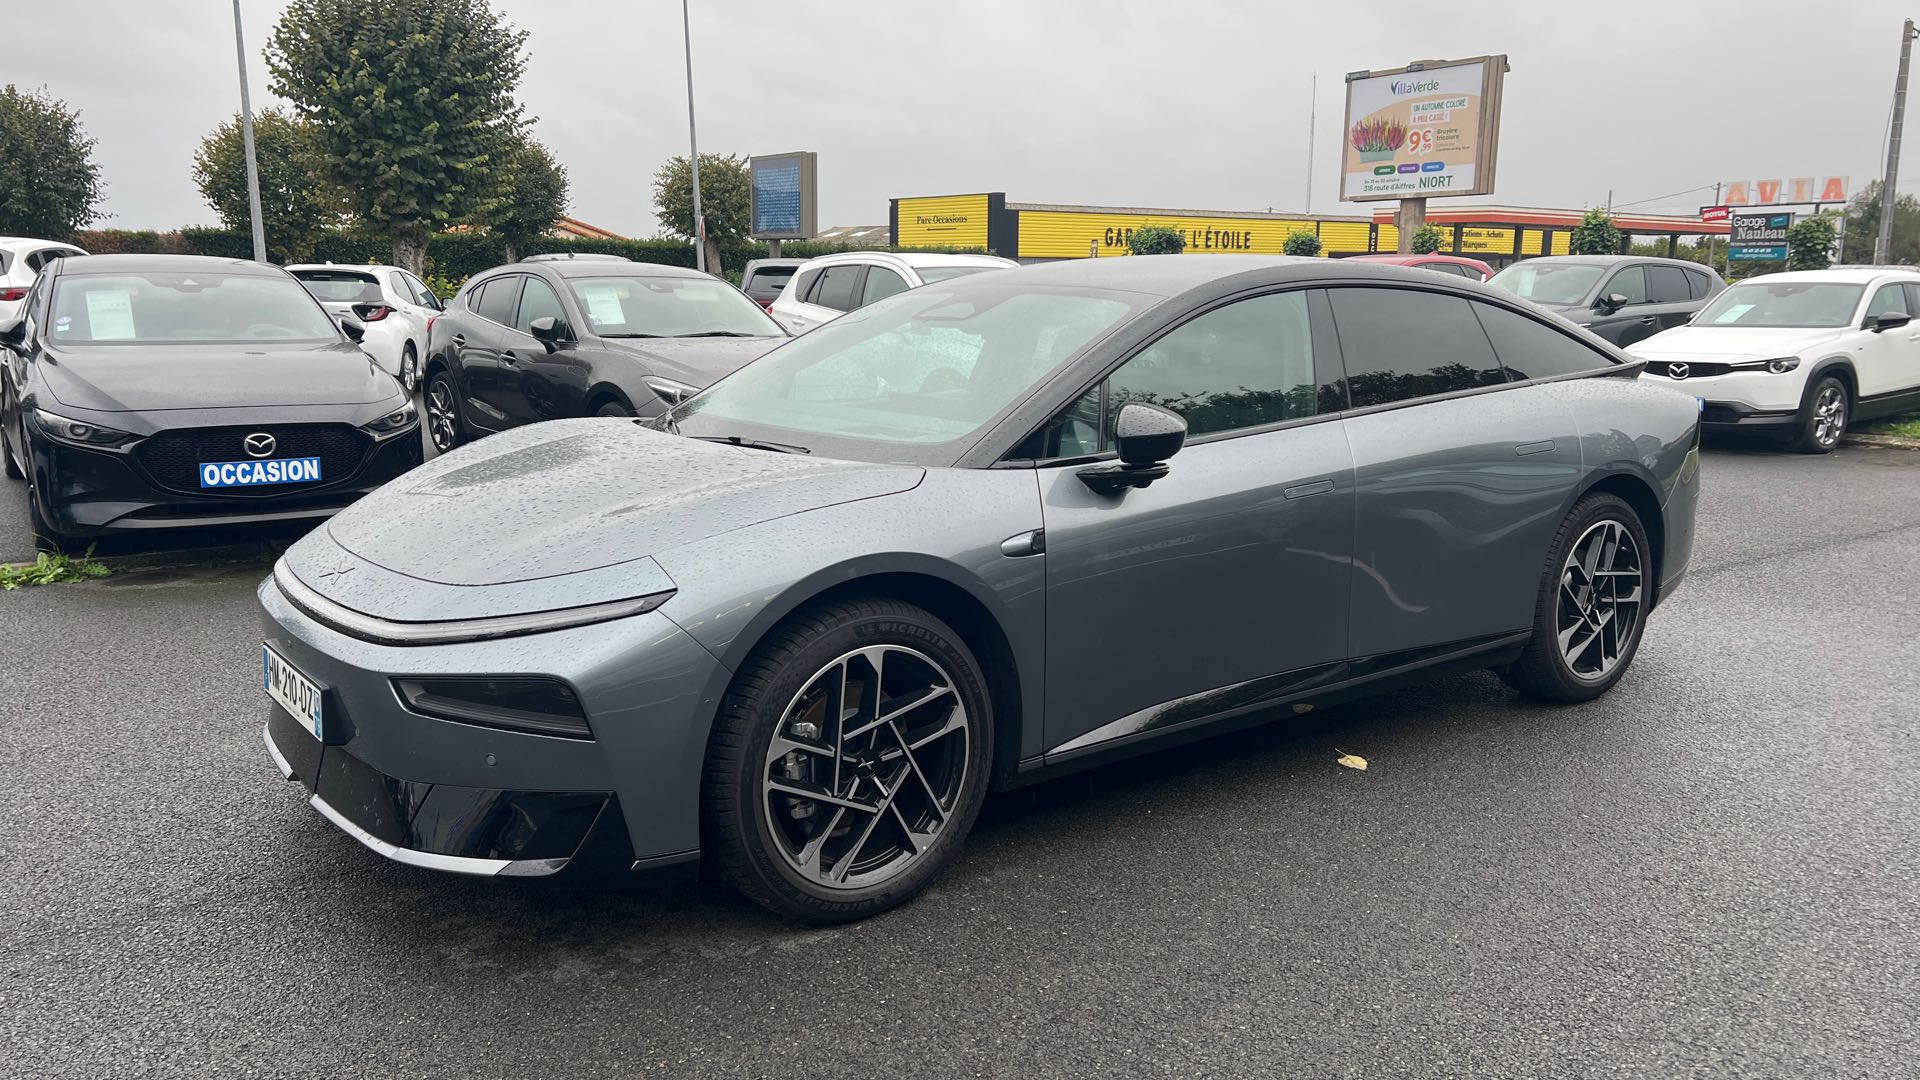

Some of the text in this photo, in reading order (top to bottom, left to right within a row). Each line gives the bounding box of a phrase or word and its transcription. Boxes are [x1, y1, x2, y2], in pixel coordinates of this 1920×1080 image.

[1391, 80, 1439, 95] VillaVerde
[1419, 175, 1453, 188] NIORT
[1725, 178, 1845, 204] AVIA
[916, 214, 967, 224] Parc Occasions
[1733, 216, 1766, 228] Garage
[1193, 226, 1251, 249] L'ÉTOILE
[1737, 227, 1786, 240] Nauleau
[203, 460, 319, 485] OCCASION
[879, 622, 948, 649] MICHELIN
